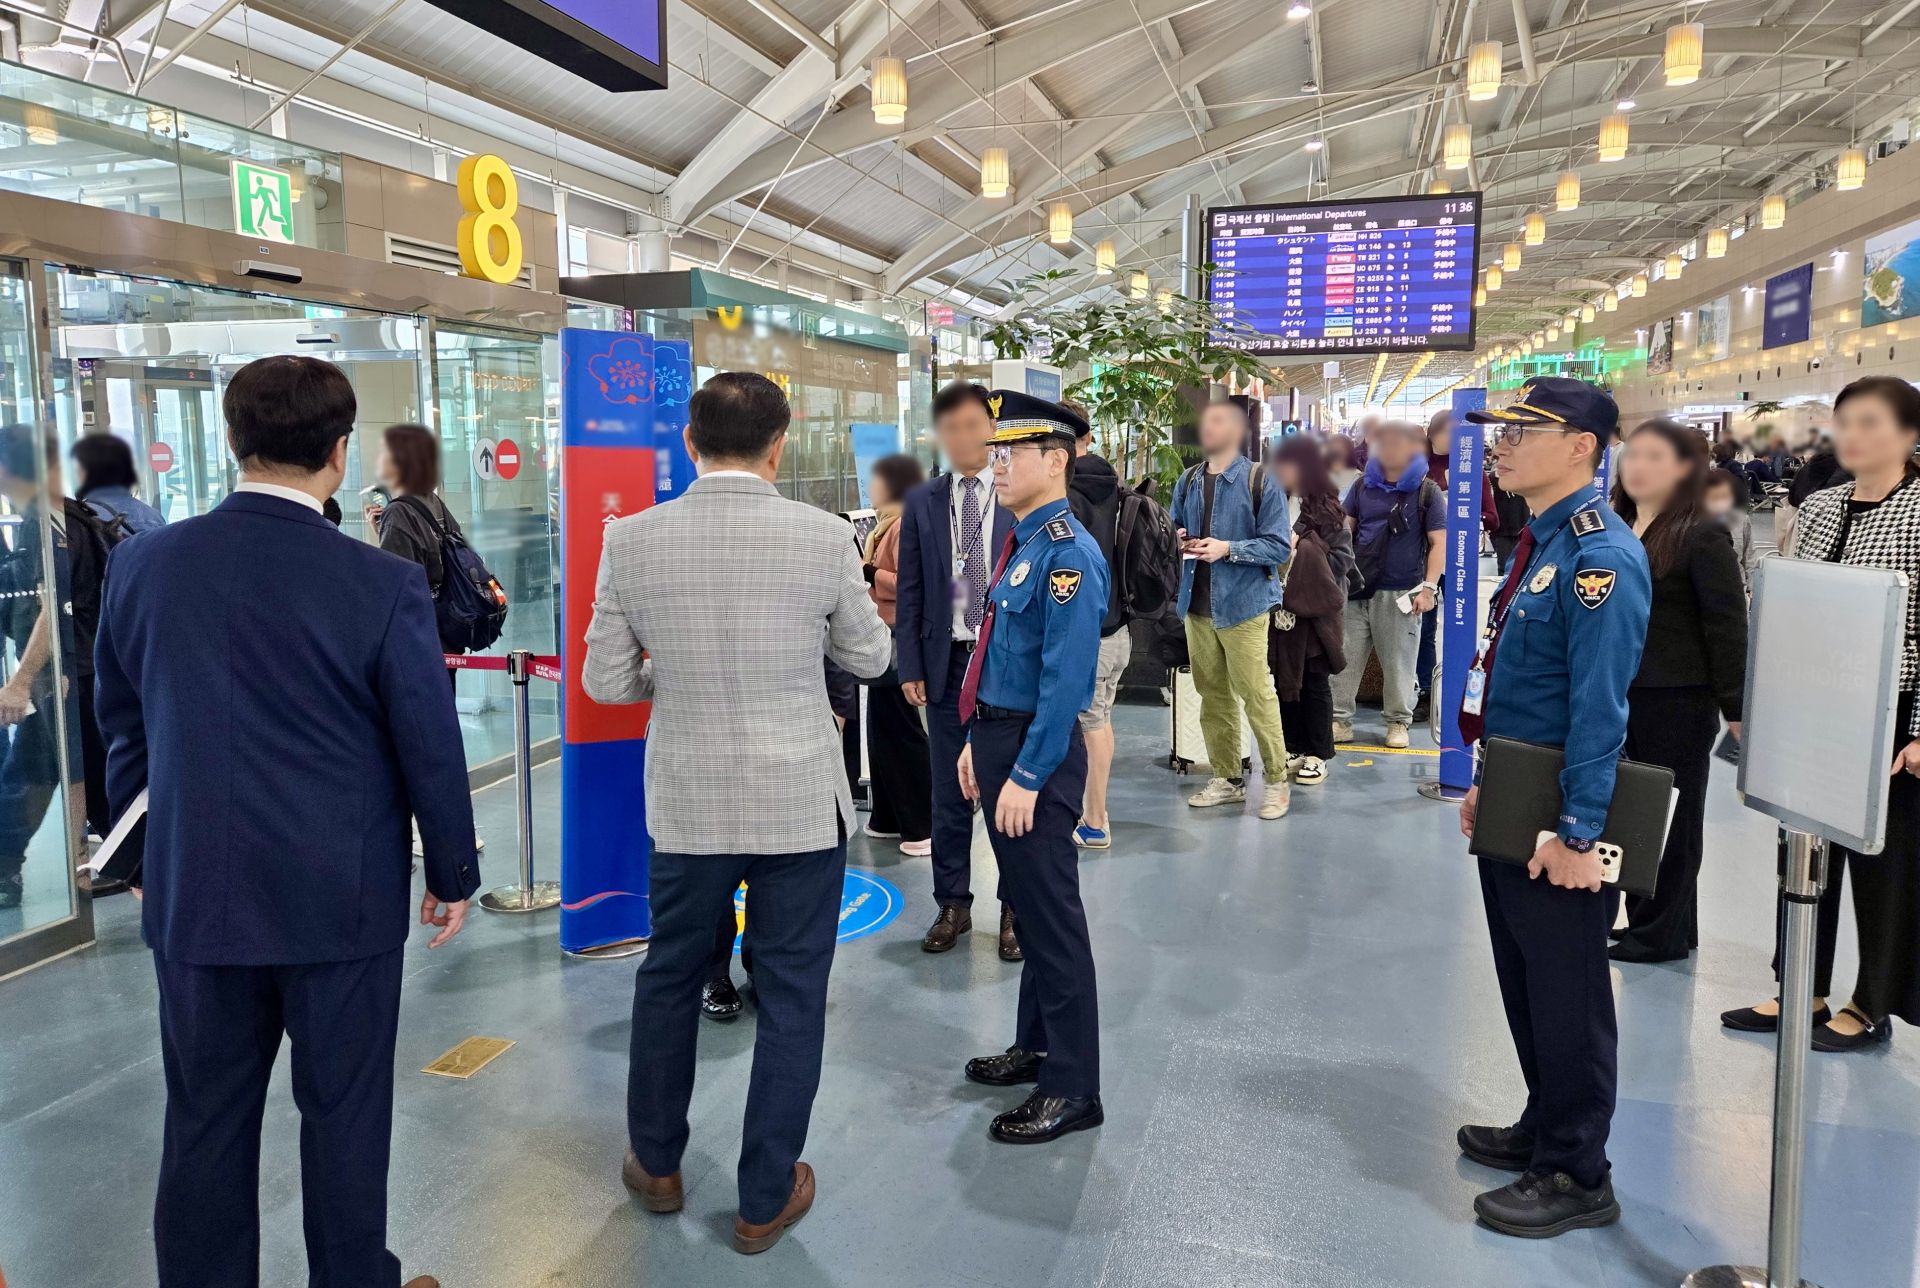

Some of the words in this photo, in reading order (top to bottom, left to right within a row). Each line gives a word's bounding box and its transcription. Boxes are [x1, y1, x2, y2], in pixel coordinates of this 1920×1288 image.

[457, 153, 522, 283] 8
[1228, 214, 1252, 225] 국제선
[1276, 211, 1322, 222] International
[1325, 209, 1366, 220] Departures
[1277, 236, 1315, 245] タシュケント
[1284, 309, 1303, 317] ハノイ
[1318, 338, 1335, 347] 눌러
[1337, 337, 1354, 346] 안내
[1357, 336, 1390, 346] 받으시기
[1392, 335, 1429, 345] 바랍니다.
[1459, 436, 1473, 473] 經濟艙
[1457, 481, 1471, 518] 第一區
[1456, 530, 1467, 567] Economy
[1457, 569, 1466, 592] Class
[1456, 598, 1465, 618] Zone
